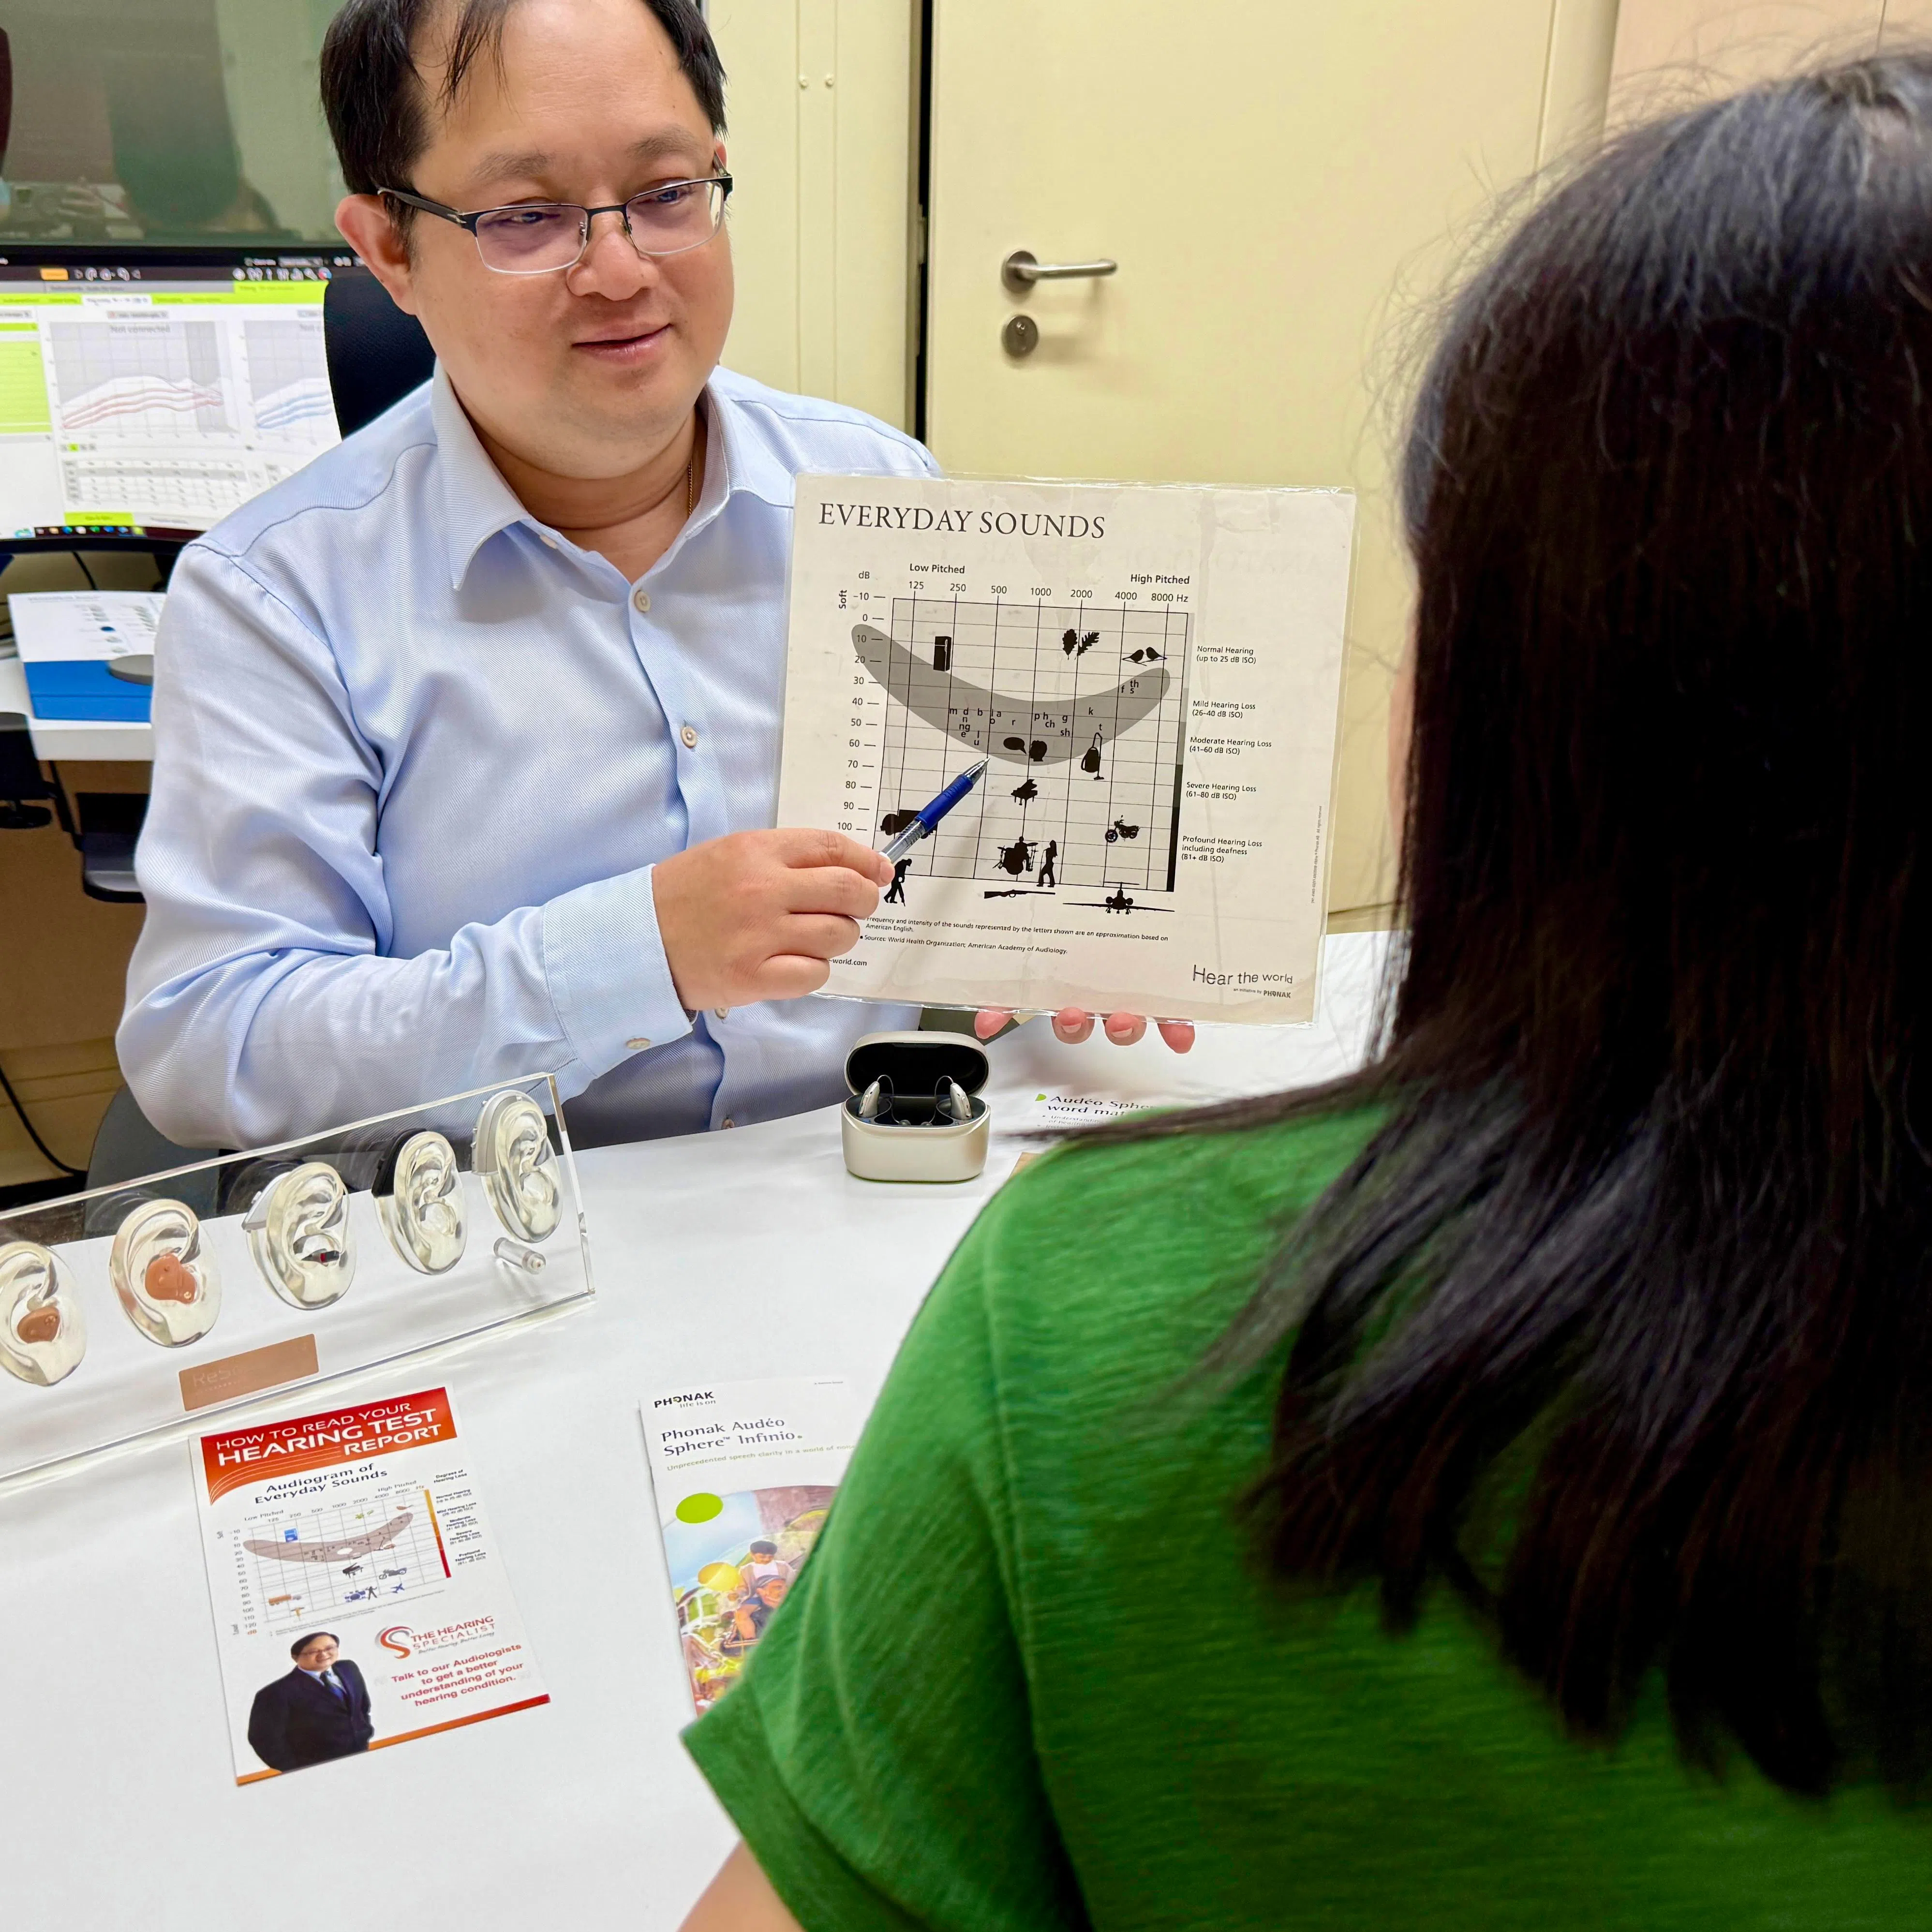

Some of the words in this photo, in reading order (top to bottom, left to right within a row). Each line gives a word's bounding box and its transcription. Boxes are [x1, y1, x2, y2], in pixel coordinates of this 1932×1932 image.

[818, 503, 973, 533] EVERYDAY
[980, 511, 1105, 539] SOUNDS
[859, 571, 870, 579] dB
[909, 564, 928, 572] Low
[931, 564, 965, 574] Pitched
[1130, 575, 1152, 584] High
[1155, 575, 1189, 584] Pitched
[839, 590, 847, 609] Soft
[909, 581, 923, 590] 125
[950, 584, 966, 592] 250
[1030, 588, 1051, 596] 1000
[1070, 590, 1092, 598] 2000
[1151, 593, 1174, 602] 8000
[1177, 594, 1188, 603] Hz
[1226, 647, 1253, 655] Hearing
[1211, 701, 1239, 710] Hearing
[1190, 737, 1225, 745] Moderate
[1227, 739, 1255, 747] Hearing
[1212, 784, 1240, 792] Hearing
[1182, 845, 1214, 853] including
[1217, 847, 1247, 855] deafness
[1183, 835, 1215, 844] Profound
[1218, 838, 1246, 847] Hearing
[1193, 965, 1233, 985] Hear
[1238, 972, 1258, 983] the
[1263, 974, 1293, 984] world
[1050, 1096, 1103, 1105] Audéo
[654, 1391, 713, 1408] PHONAK
[216, 1433, 264, 1450] HOW
[272, 1427, 297, 1440] TO
[303, 1415, 354, 1433] READ
[358, 1403, 412, 1421] YOUR
[219, 1426, 362, 1466] HEARING
[367, 1409, 437, 1433] TEST
[661, 1423, 726, 1442] Phonak
[732, 1418, 785, 1431] Audéo
[345, 1425, 442, 1455] REPORT
[667, 1456, 726, 1471] Unprecedented
[729, 1453, 756, 1461] speech
[758, 1449, 782, 1457] clarity
[254, 1481, 330, 1505] Everyday
[332, 1470, 388, 1488] Sounds
[267, 1469, 354, 1494] Audiogram
[359, 1463, 374, 1473] of
[411, 1632, 435, 1642] THE
[438, 1616, 493, 1636] HEARING
[414, 1623, 495, 1650] SPECIALIST
[392, 1672, 414, 1683] Talk
[417, 1668, 428, 1677] to
[431, 1663, 450, 1673] our
[453, 1644, 522, 1667] Audiologists
[421, 1677, 432, 1685] to
[437, 1672, 453, 1683] get
[466, 1659, 498, 1673] better
[401, 1673, 482, 1700] understanding
[485, 1669, 497, 1678] of
[499, 1662, 523, 1675] your
[415, 1691, 458, 1707] hearing
[461, 1677, 516, 1694] condition.
